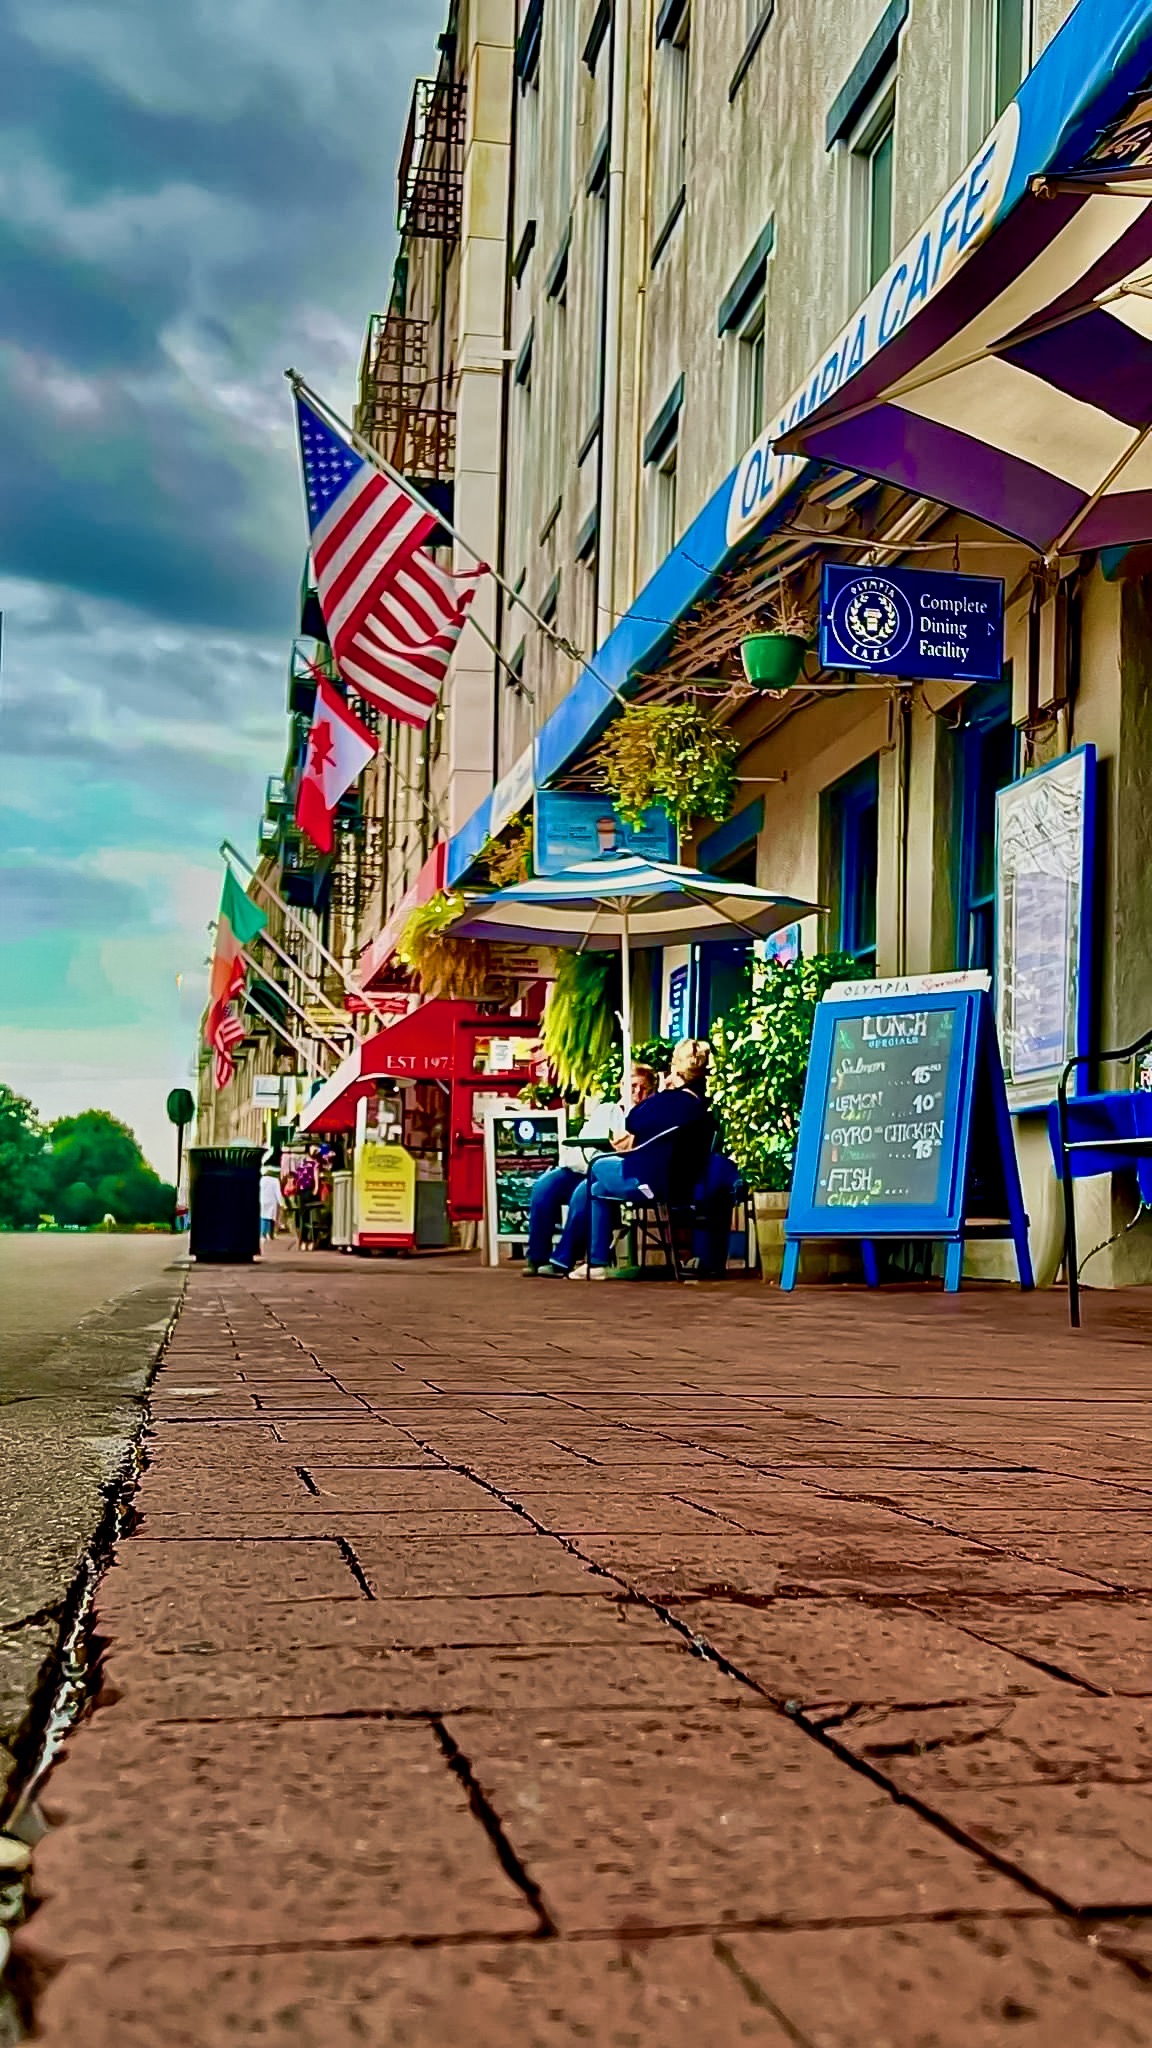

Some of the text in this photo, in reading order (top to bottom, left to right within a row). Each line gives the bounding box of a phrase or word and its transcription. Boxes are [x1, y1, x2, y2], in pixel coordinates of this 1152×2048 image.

[878, 140, 997, 349] CAFE
[850, 580, 895, 598] OLYMPIA
[919, 593, 988, 617] Complete
[919, 616, 968, 640] Dining
[919, 639, 970, 663] Facility
[843, 981, 910, 997] OLYMPIA
[861, 1011, 928, 1041] LUNCH
[386, 1055, 417, 1070] EST
[835, 1091, 883, 1112] LEMON
[831, 1125, 873, 1147] GYRO
[826, 1167, 873, 1193] FISH
